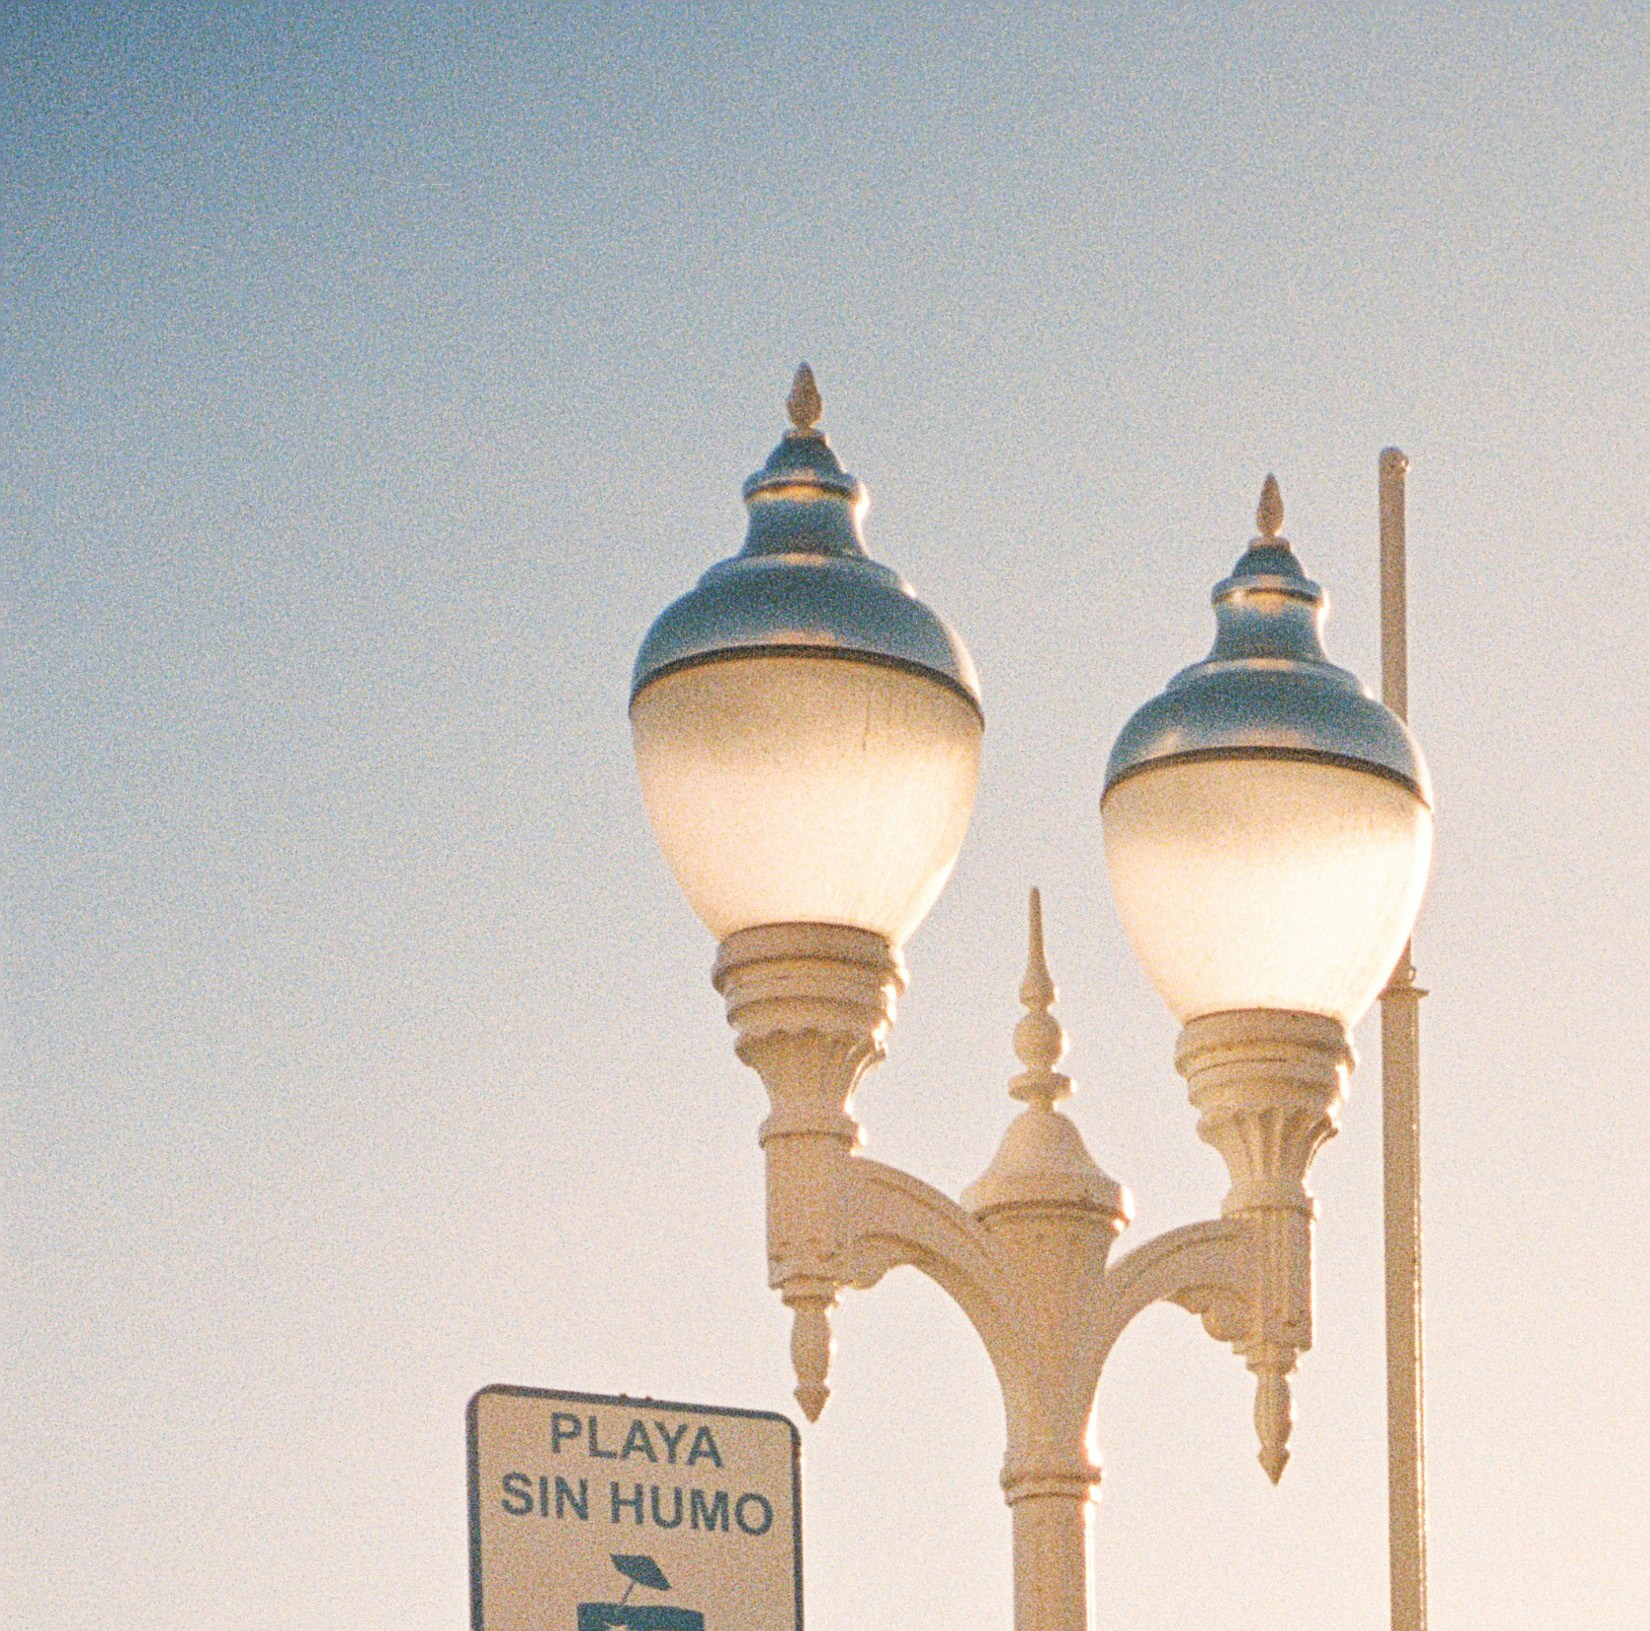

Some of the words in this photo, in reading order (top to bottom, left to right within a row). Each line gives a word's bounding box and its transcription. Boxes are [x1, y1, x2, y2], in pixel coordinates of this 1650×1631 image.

[550, 1411, 724, 1469] PLAYA
[501, 1471, 590, 1522] SIN
[610, 1481, 774, 1537] HUMO
